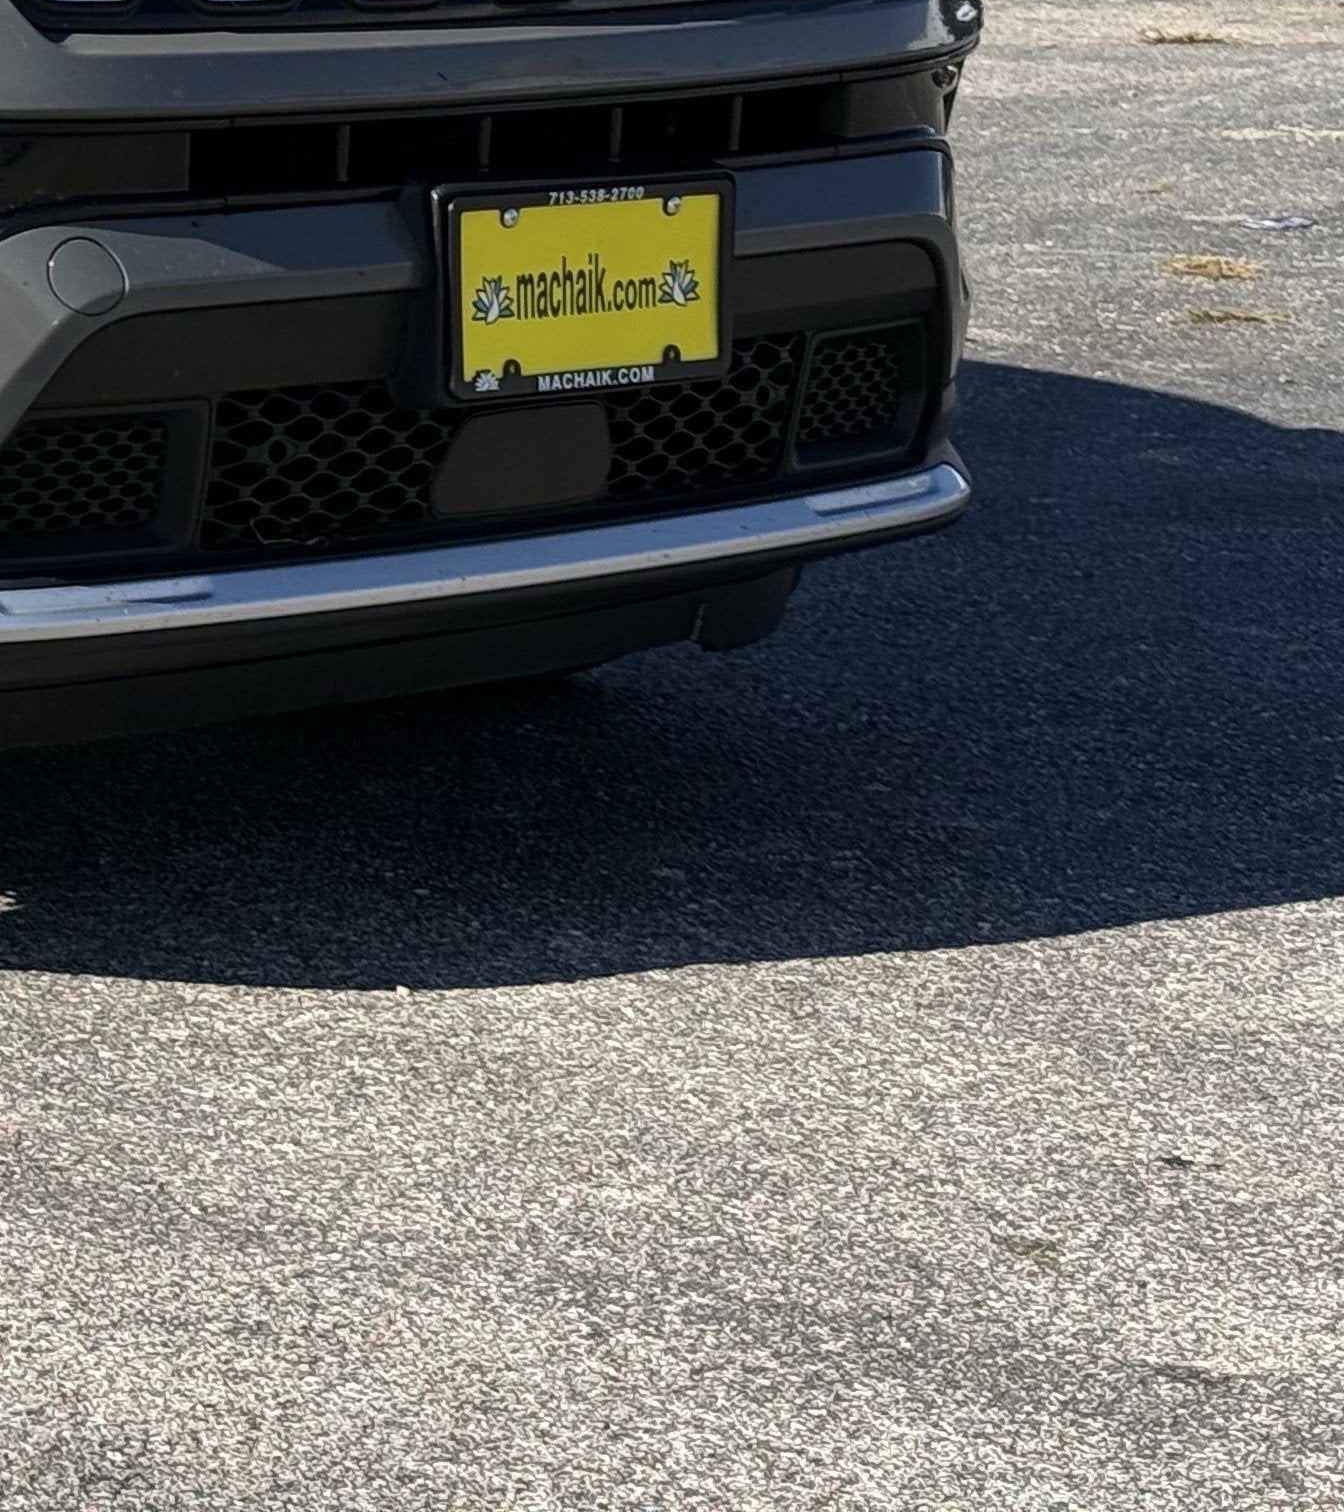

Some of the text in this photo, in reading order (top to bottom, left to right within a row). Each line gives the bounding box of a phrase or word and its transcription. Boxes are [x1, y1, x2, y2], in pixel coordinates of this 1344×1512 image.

[548, 185, 645, 206] 713-538-2700
[516, 253, 658, 320] machaik.com
[537, 366, 656, 393] MACHAIK.COM
